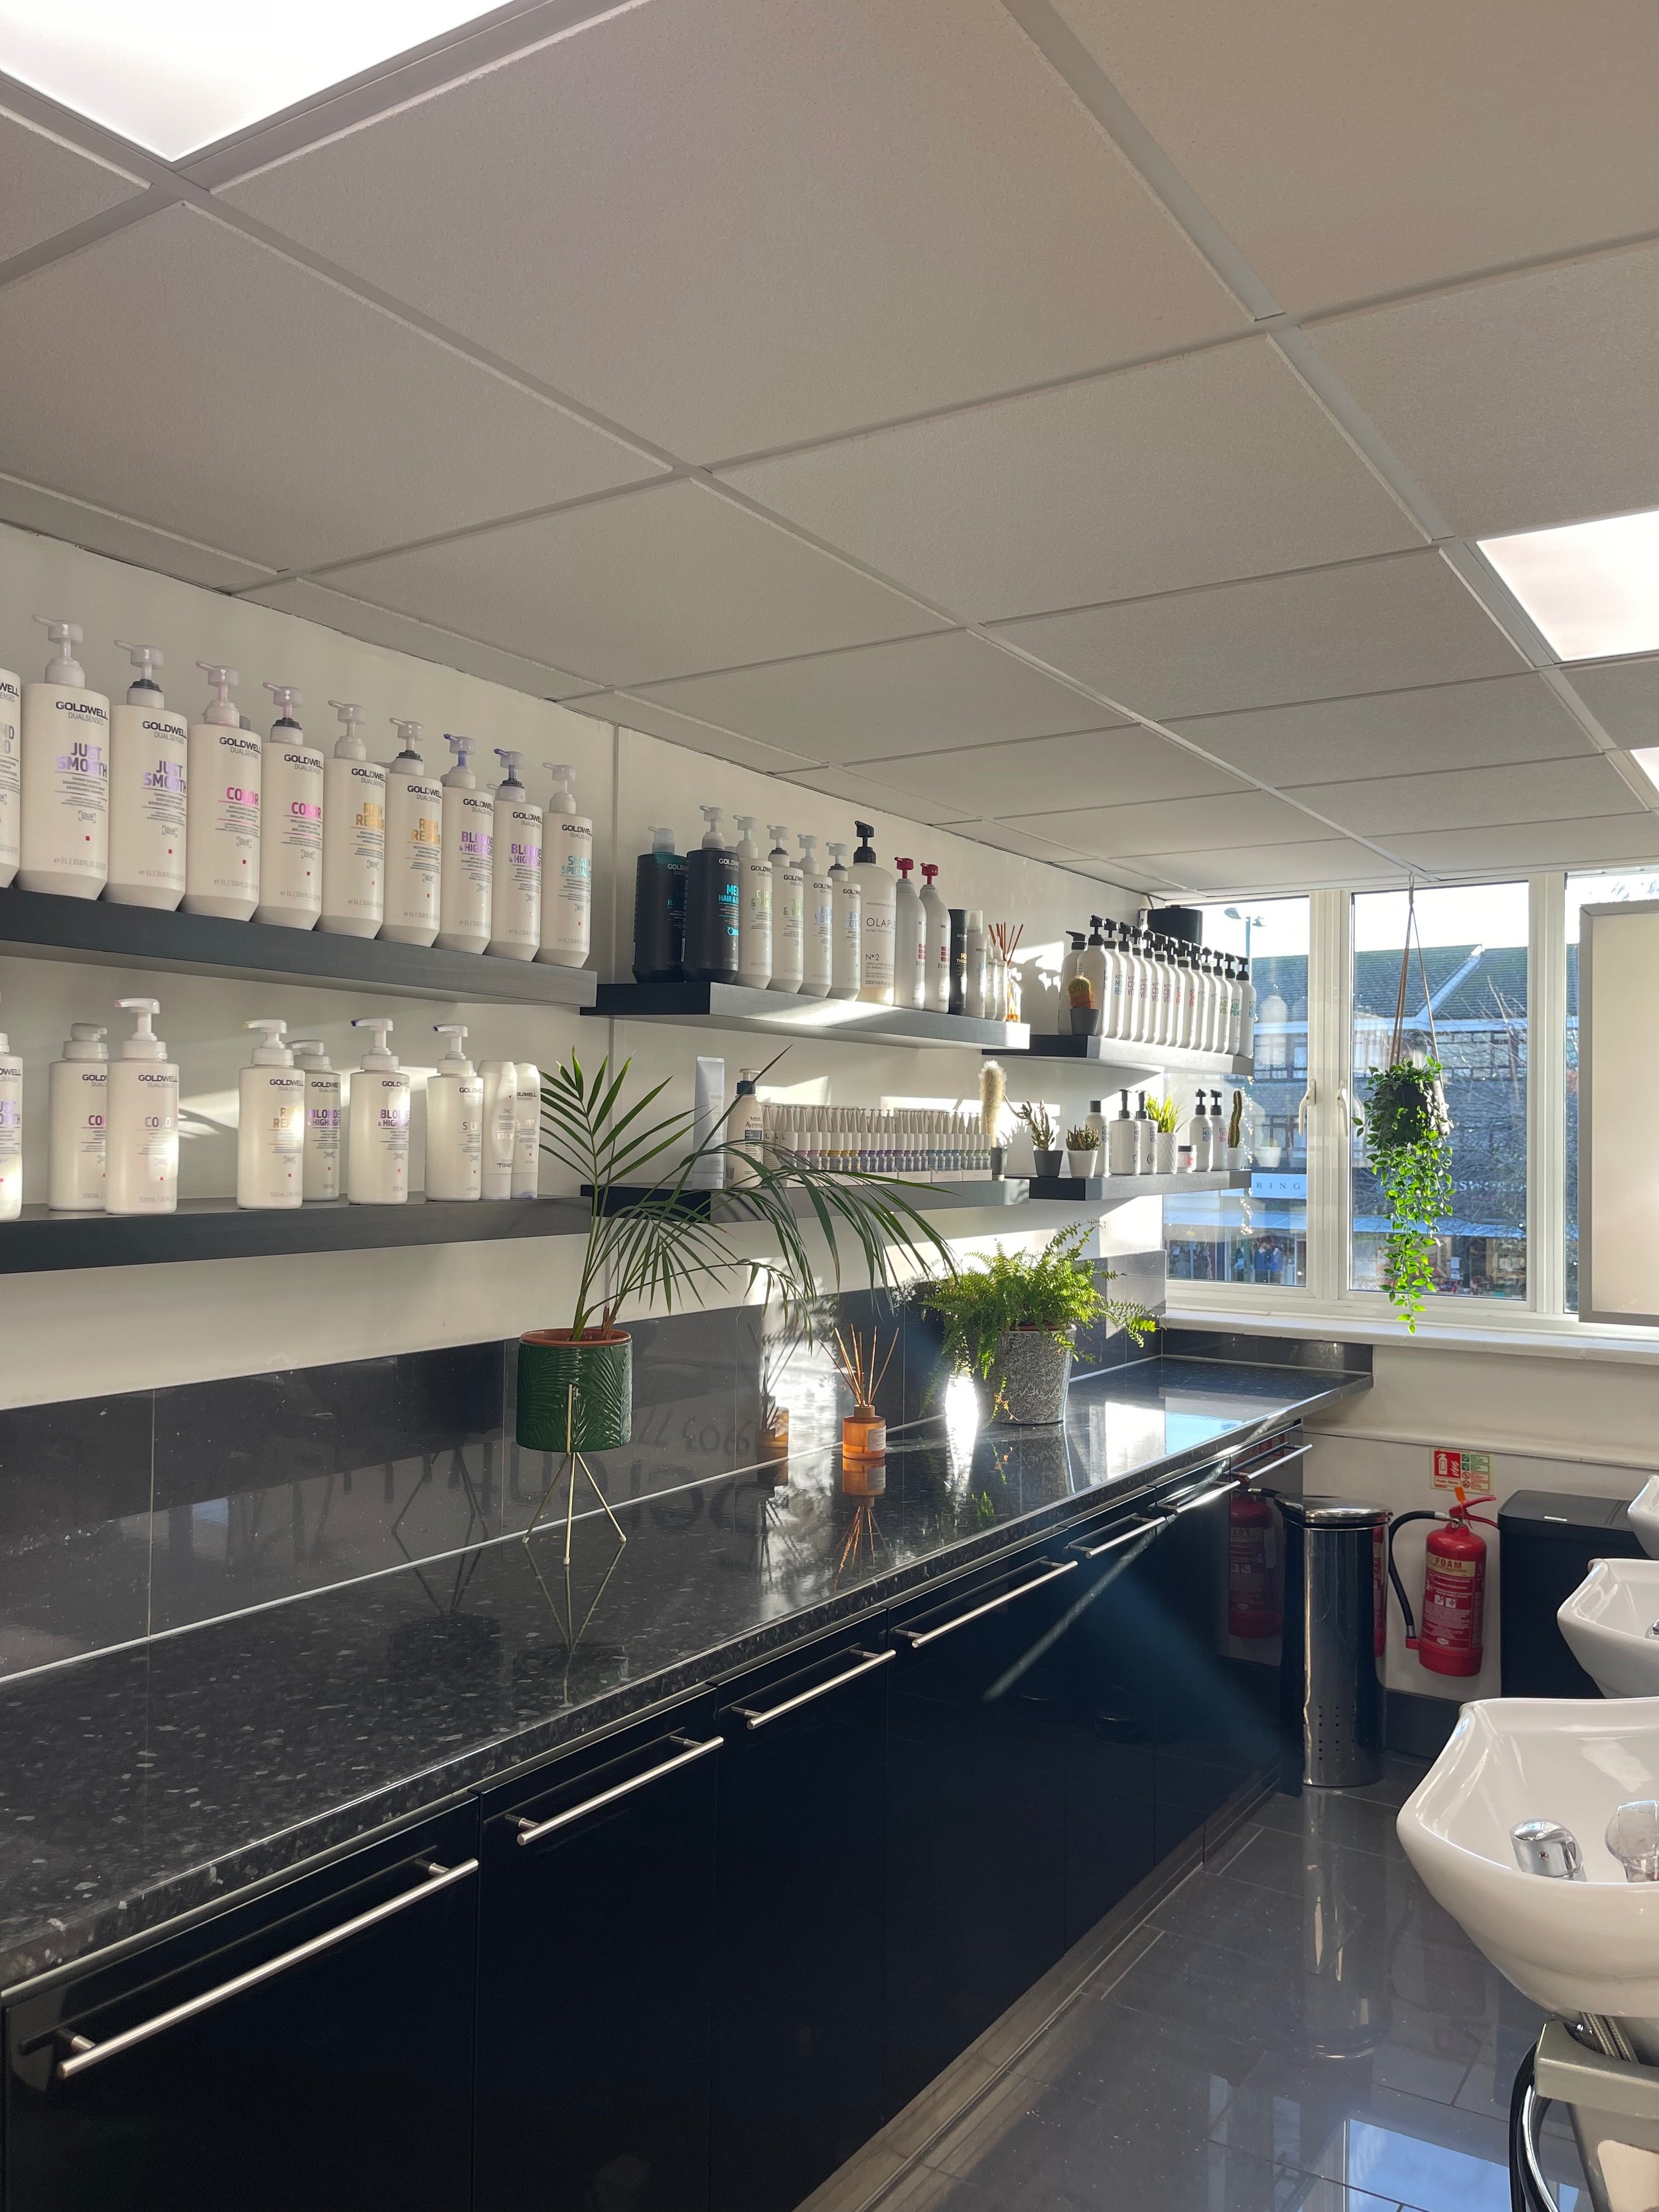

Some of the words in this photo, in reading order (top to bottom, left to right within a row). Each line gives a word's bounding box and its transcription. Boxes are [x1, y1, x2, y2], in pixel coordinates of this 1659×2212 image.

[56, 701, 108, 719] GOLDWELL
[68, 711, 104, 725] DUALSENSES
[142, 721, 187, 739] GOLDWELL
[154, 731, 184, 744] DUALSENSES
[70, 742, 102, 761] JUST
[219, 737, 261, 755] GOLDWELL
[56, 754, 108, 778] SMOOTH
[156, 760, 182, 778] JUST
[283, 754, 323, 770] GOLDWELL
[142, 772, 186, 793] SMOOTH
[226, 786, 259, 806] COLOR
[291, 802, 321, 820] COLOR
[461, 831, 493, 848] BLONDE
[866, 917, 896, 930] OLAPLE
[1435, 1557, 1462, 1570] FOAM
